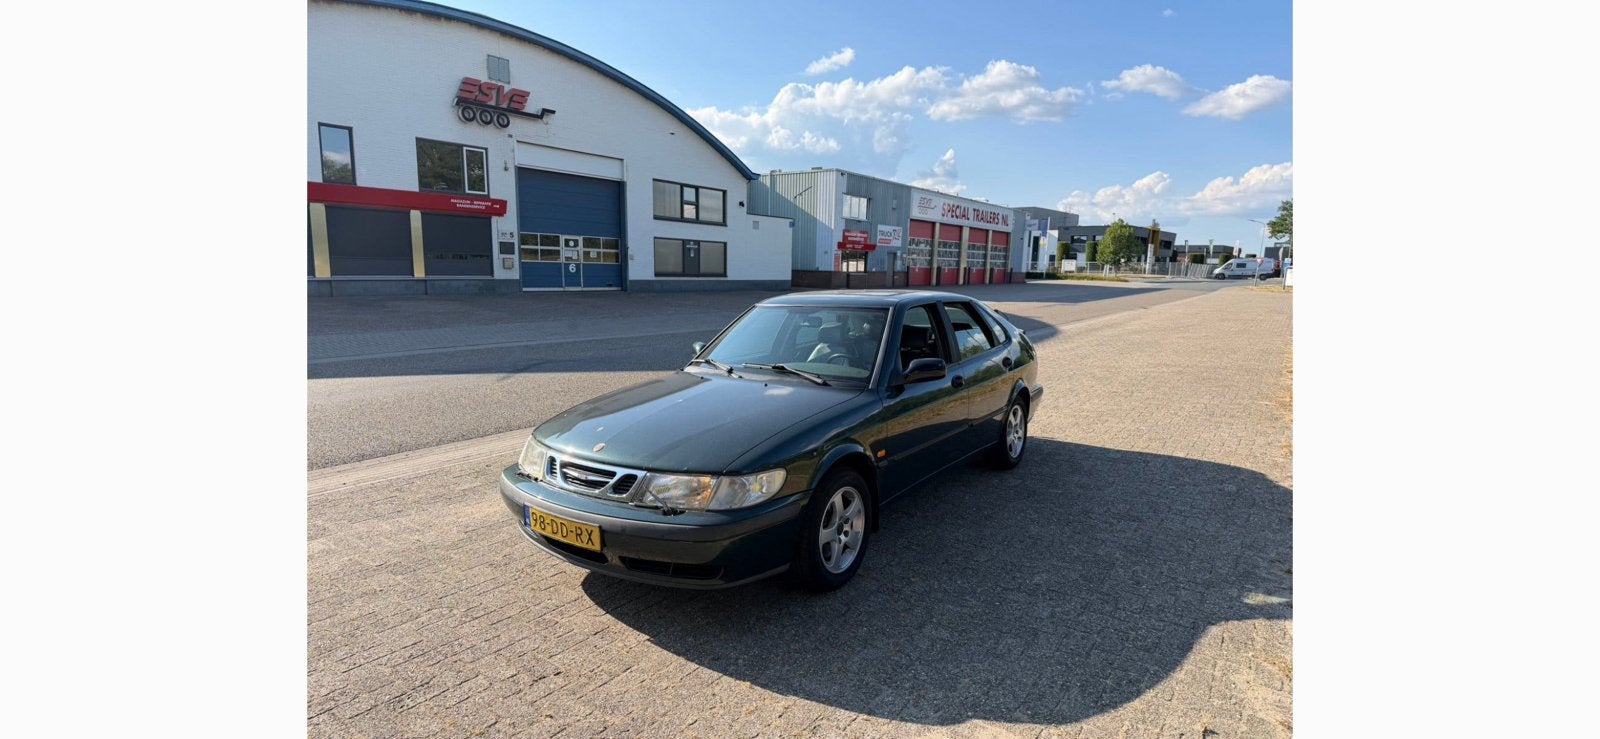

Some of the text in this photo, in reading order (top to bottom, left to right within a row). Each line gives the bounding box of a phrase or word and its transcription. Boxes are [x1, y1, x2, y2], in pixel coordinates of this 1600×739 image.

[458, 76, 531, 111] ESVE
[941, 202, 1009, 227] SPECIAL TRAILERS NL
[568, 263, 577, 273] 6
[531, 511, 595, 546] 98-DD-RX
